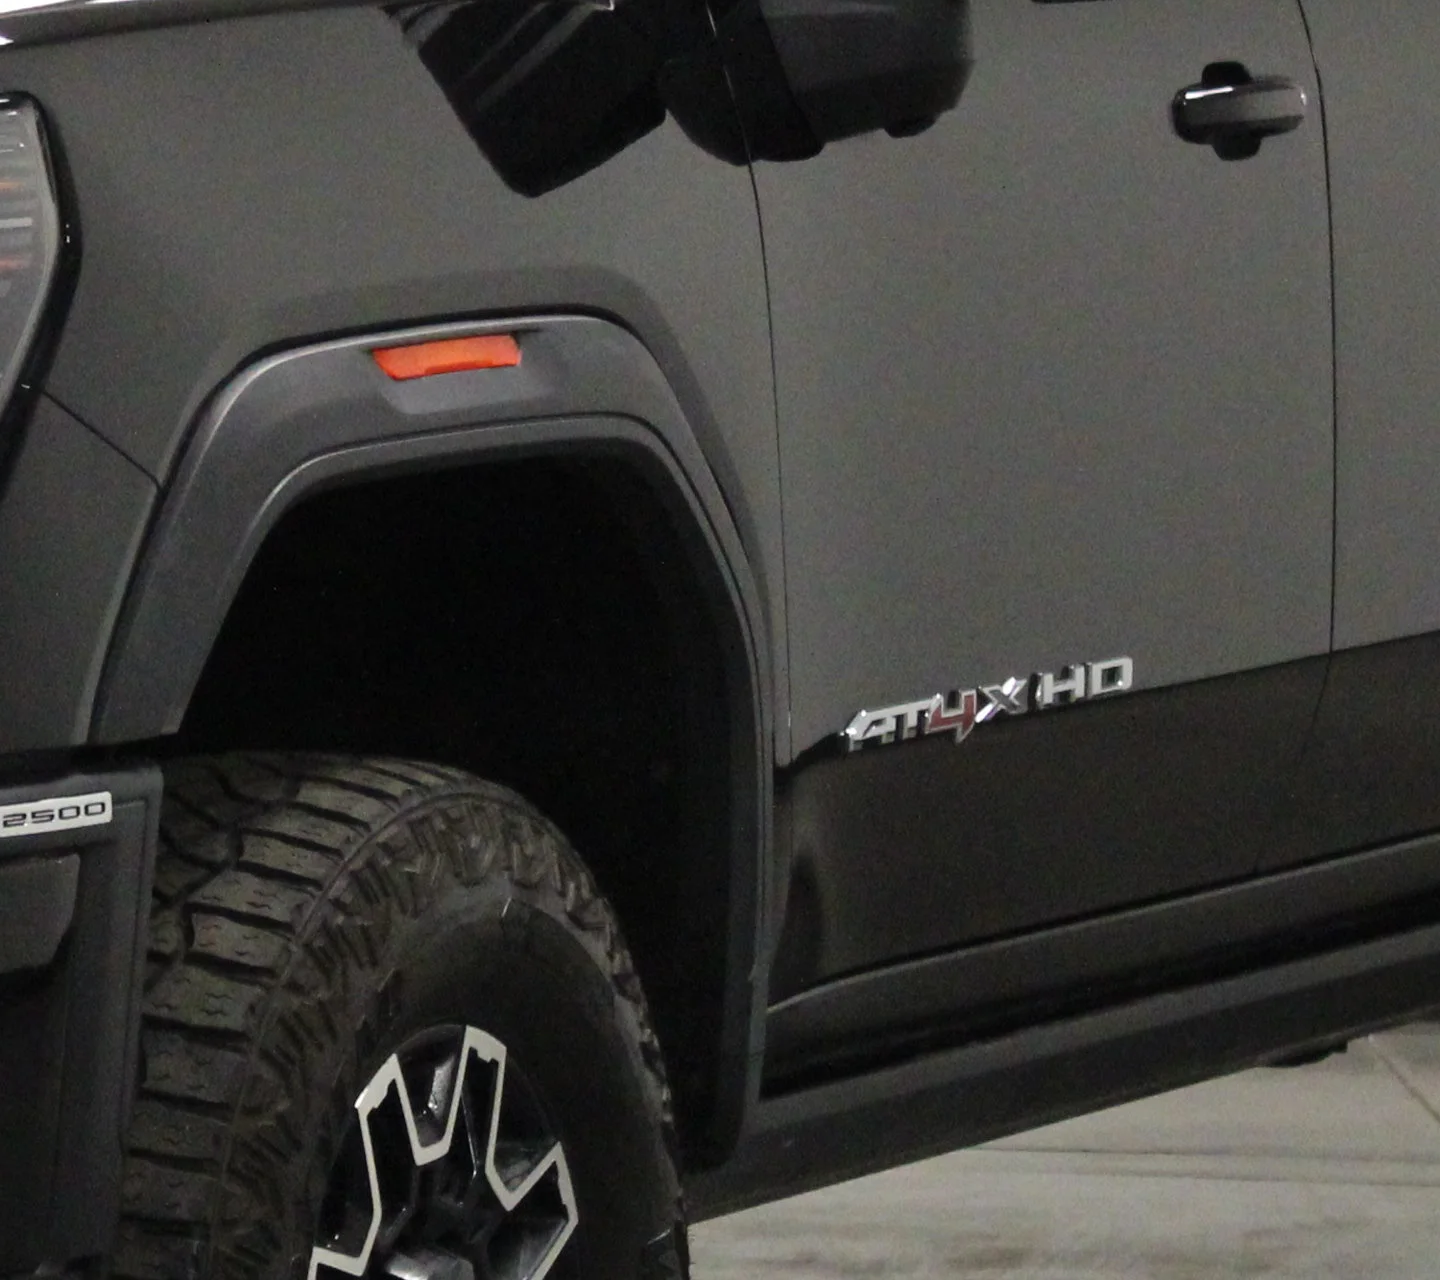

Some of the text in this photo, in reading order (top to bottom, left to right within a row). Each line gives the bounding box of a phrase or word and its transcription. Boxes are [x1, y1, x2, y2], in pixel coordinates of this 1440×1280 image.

[839, 655, 1134, 753] AT4X HD
[2, 800, 107, 829] 2500
